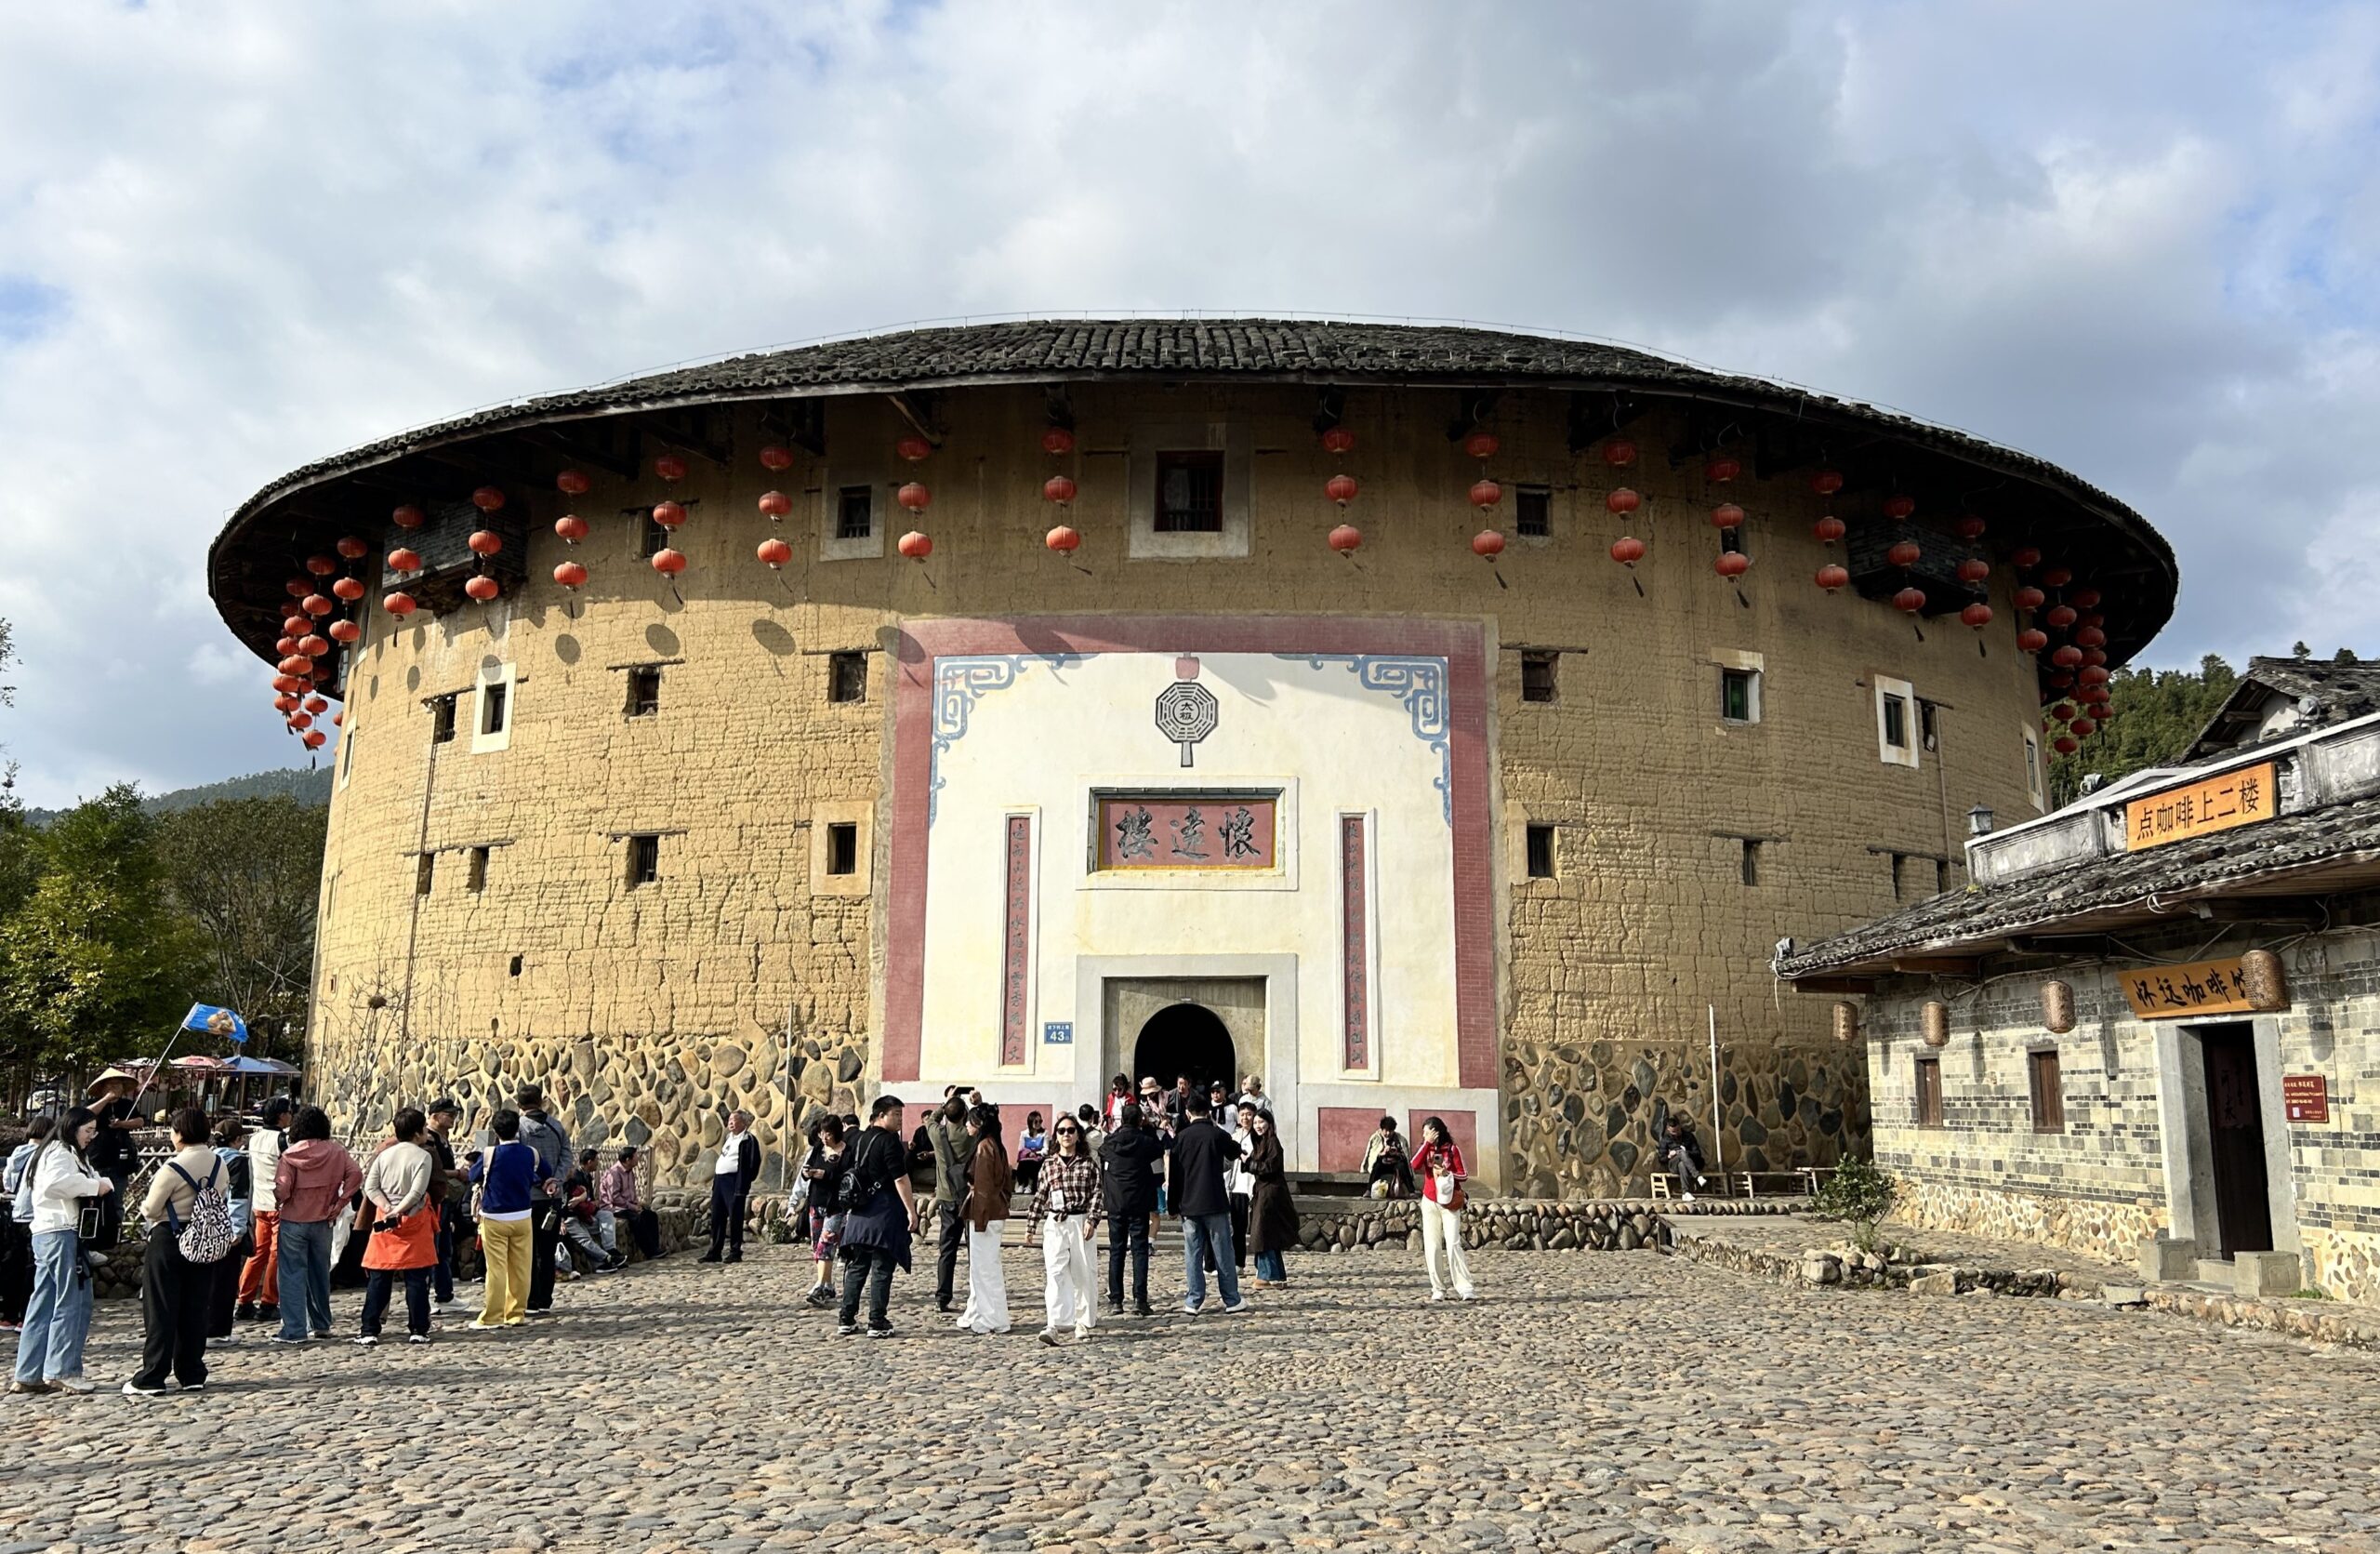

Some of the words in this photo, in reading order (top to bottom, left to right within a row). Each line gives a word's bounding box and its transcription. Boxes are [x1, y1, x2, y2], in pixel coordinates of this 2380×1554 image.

[2136, 777, 2260, 841] 点咖啡上二楼
